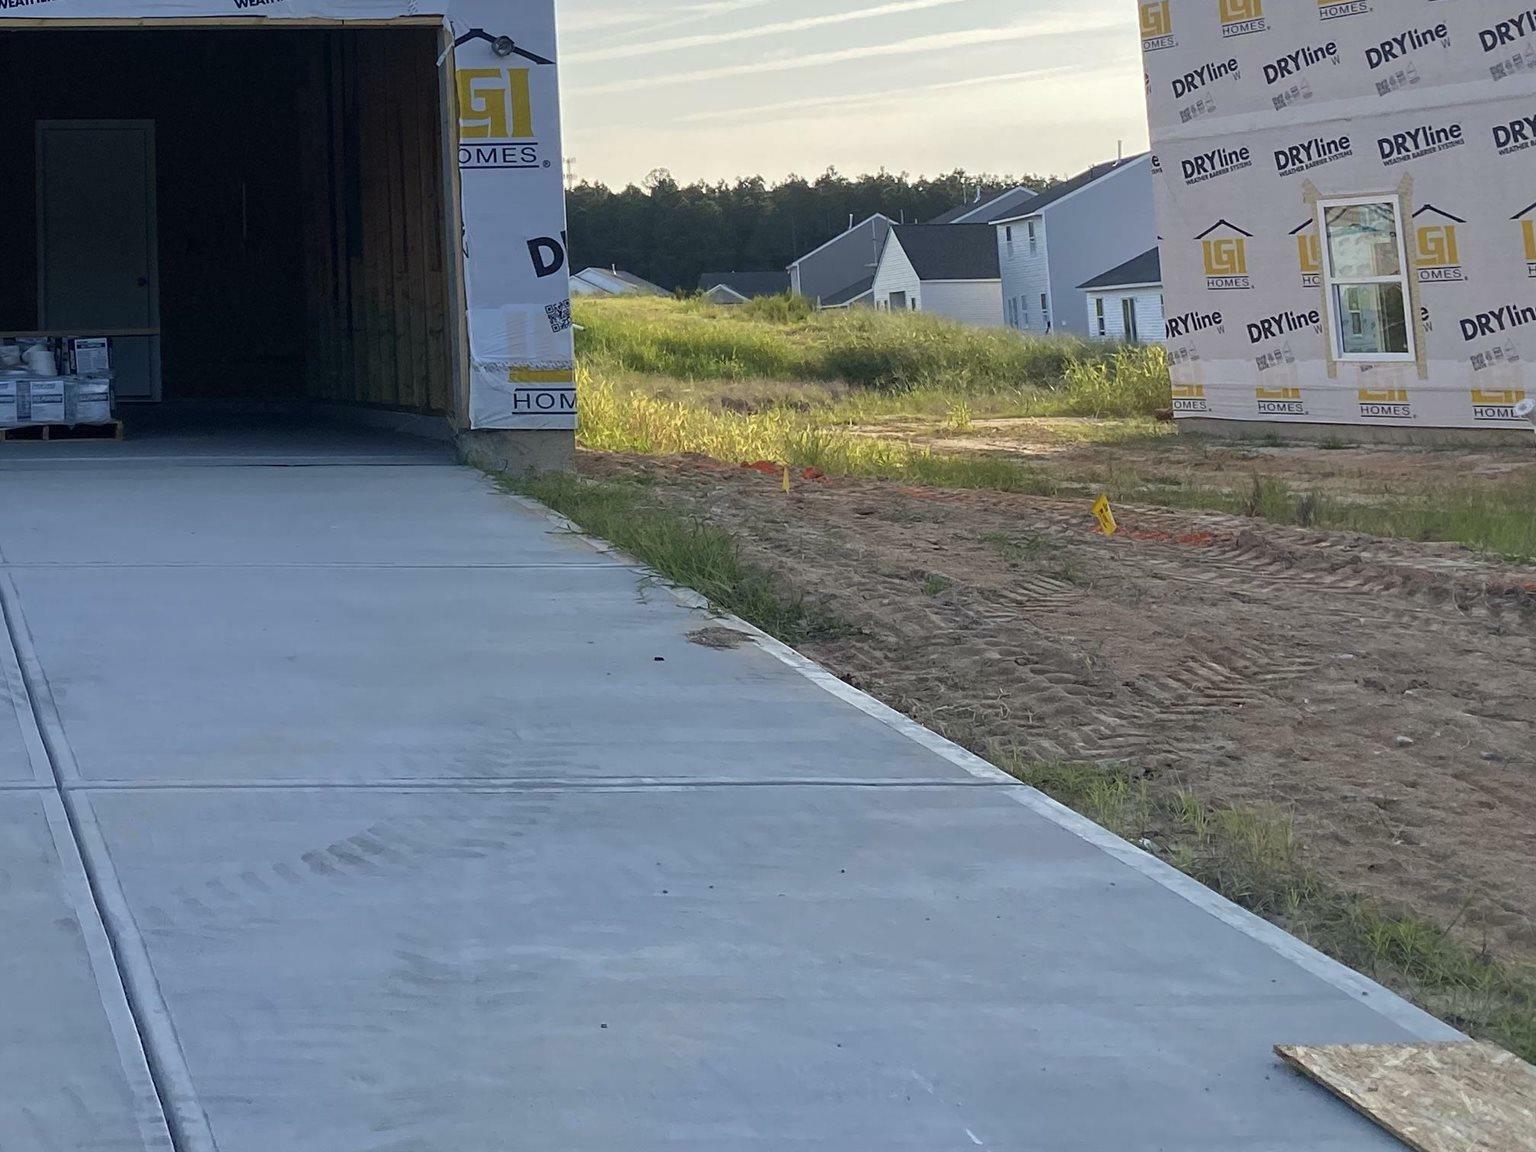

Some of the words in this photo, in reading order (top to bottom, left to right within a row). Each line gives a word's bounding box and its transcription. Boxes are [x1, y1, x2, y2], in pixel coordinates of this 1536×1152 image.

[1319, 1, 1368, 19] HOMES
[1222, 20, 1266, 35] HOMES
[1365, 23, 1448, 69] DRYline
[1172, 57, 1238, 99] DRYline
[1263, 41, 1337, 85] DRYline
[1274, 136, 1350, 171] DRYline
[1377, 123, 1462, 160] DRYline
[1182, 147, 1250, 179] DRYline
[1202, 238, 1247, 275] LGI
[1207, 278, 1249, 287] HOMES
[1246, 310, 1320, 343] DRYline
[1258, 402, 1303, 413] HOMES
[1360, 405, 1411, 416] HOMES
